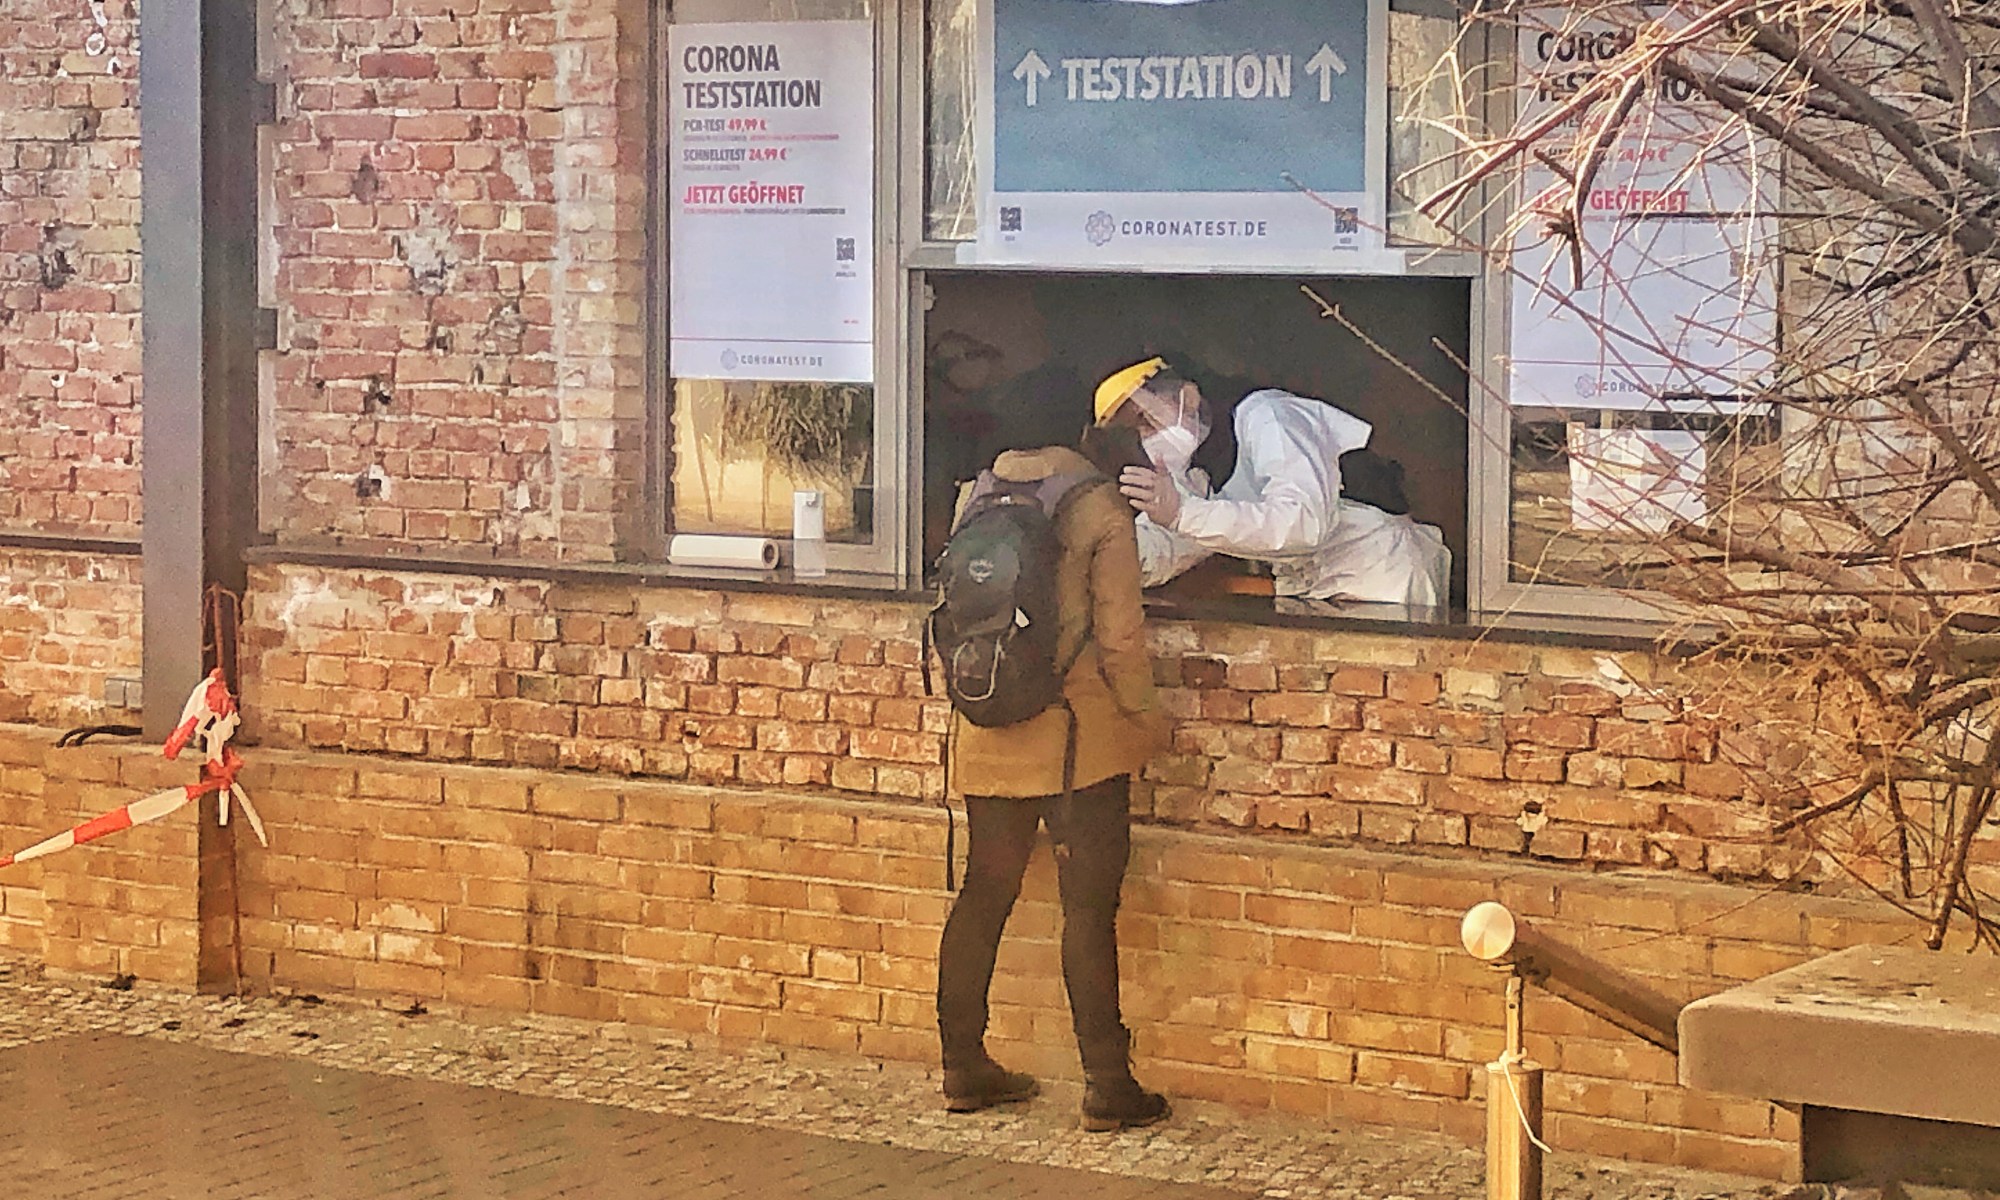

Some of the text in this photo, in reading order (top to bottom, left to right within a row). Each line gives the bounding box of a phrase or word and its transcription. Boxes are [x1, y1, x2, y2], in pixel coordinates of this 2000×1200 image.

[683, 44, 780, 73] CORONA
[1061, 54, 1292, 101] TESTSTATION
[683, 80, 821, 109] TESTSTATION
[683, 119, 725, 131] PCR-TEST
[683, 149, 745, 161] SCHNELLTEST
[683, 181, 805, 205] JETZT GEÖFFNET
[1121, 220, 1268, 236] CORONATEST.DE
